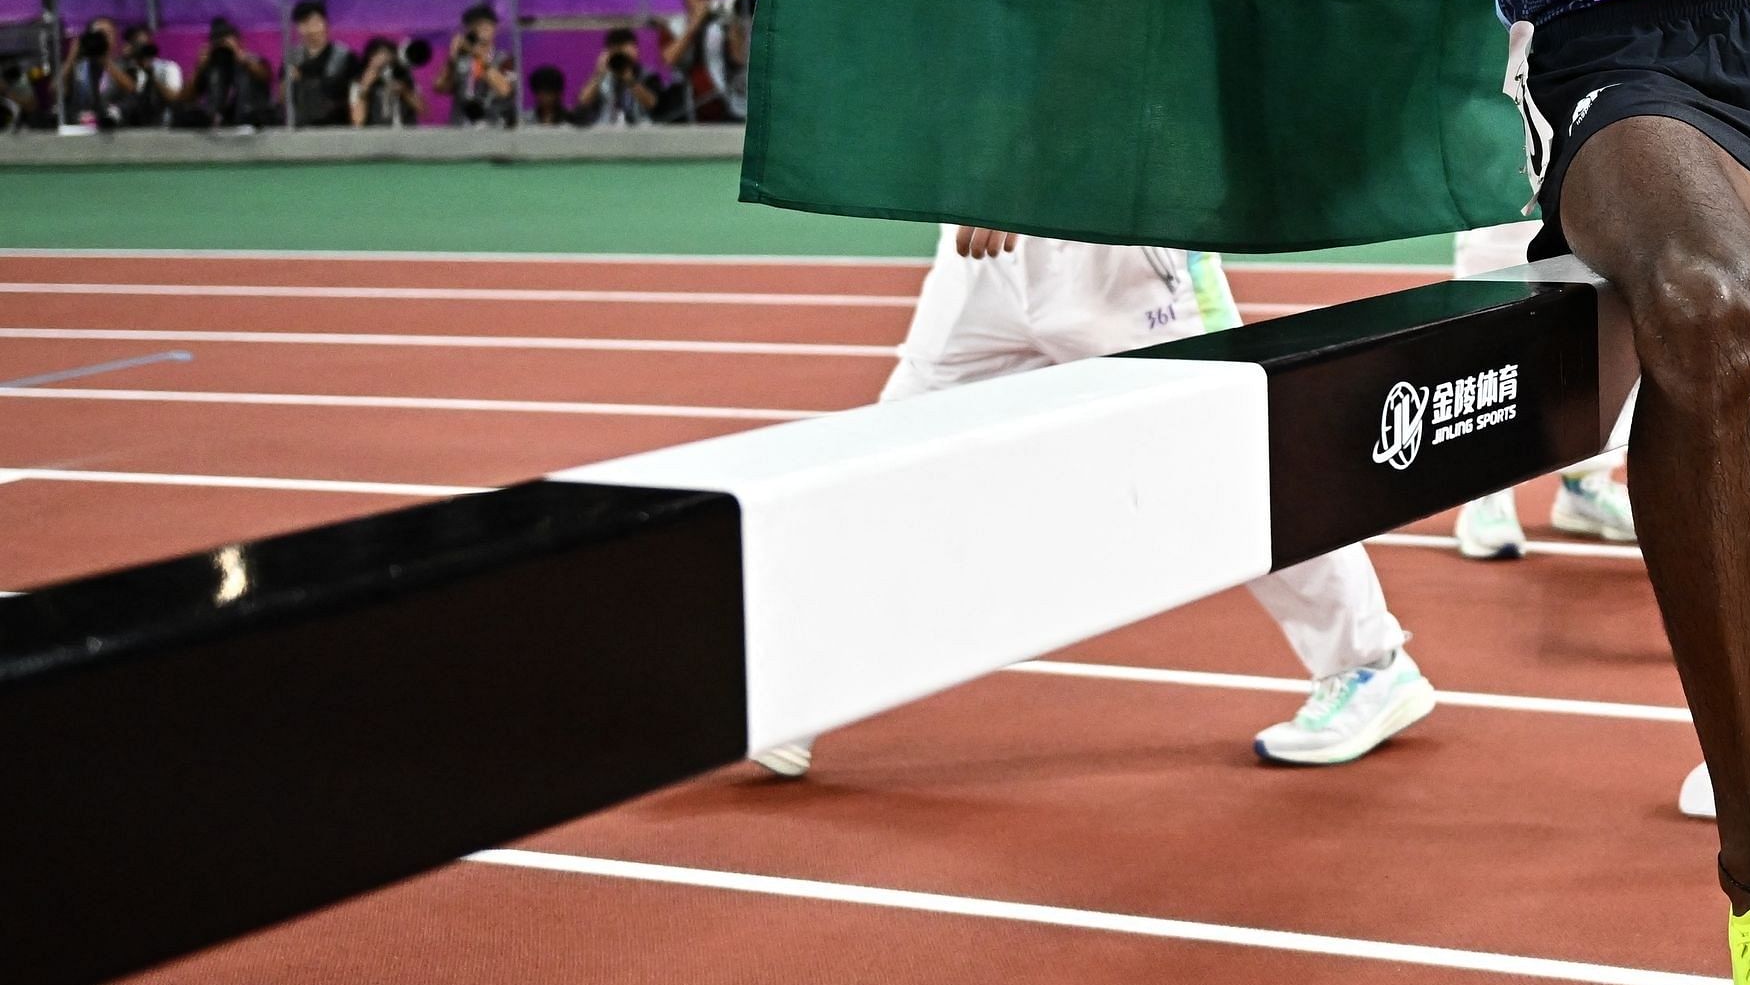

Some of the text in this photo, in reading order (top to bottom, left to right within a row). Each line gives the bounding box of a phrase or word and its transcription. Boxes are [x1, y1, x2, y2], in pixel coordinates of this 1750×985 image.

[1432, 364, 1519, 425] 金陵体育
[1432, 404, 1517, 445] JINLING SPORTS
